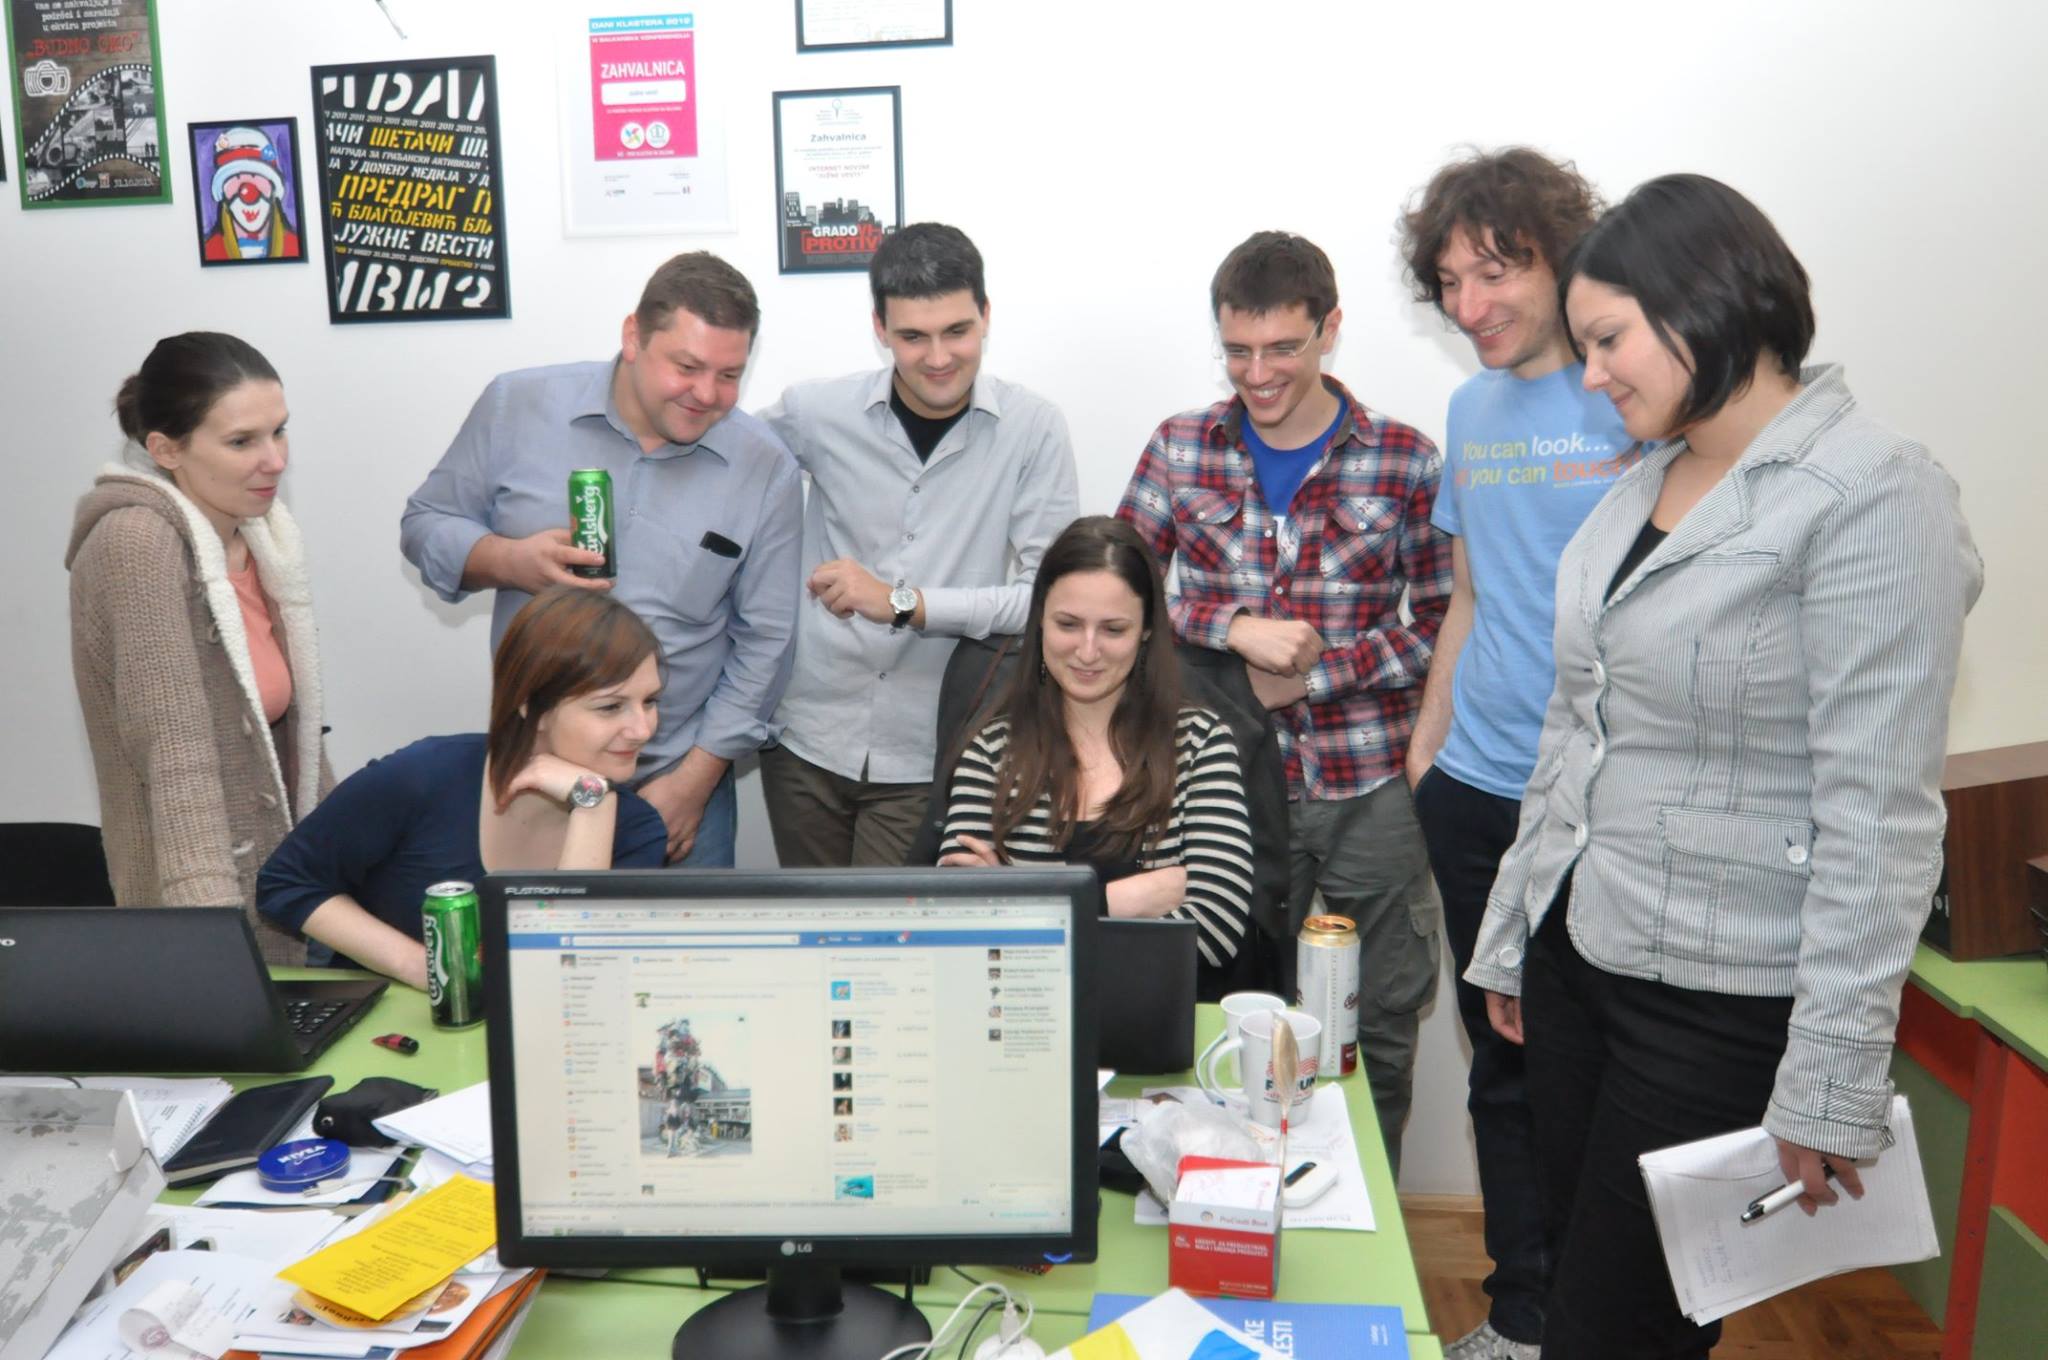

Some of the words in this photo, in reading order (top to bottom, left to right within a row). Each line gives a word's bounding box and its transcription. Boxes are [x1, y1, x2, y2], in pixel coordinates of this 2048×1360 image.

[591, 22, 614, 30] DANI
[616, 19, 666, 28] KLASTERA
[600, 60, 686, 80] ZAHVALNICA
[369, 127, 455, 154] ШЕТАЧИ
[810, 132, 867, 143] Zahvalnica
[330, 146, 367, 158] НАГРАДА
[368, 150, 380, 159] ЗА
[431, 157, 482, 170] АКТИВИЗАМ
[349, 159, 358, 171] У
[359, 160, 409, 176] ДОМЕНУ
[411, 166, 459, 183] МЕДИЈА
[338, 174, 466, 210] ПРЕДРАГ
[348, 204, 457, 232] БЛАГОЈЕВИЋ
[333, 222, 415, 250] ЈУЖНЕ
[420, 231, 495, 259] ВЕСТИ
[804, 236, 880, 252] PROTIV
[1463, 440, 1488, 461] You
[1491, 441, 1528, 459] can
[1532, 432, 1610, 456] look...
[1470, 467, 1502, 491] you
[1507, 464, 1547, 485] can
[503, 886, 560, 896] FLATRON
[797, 1242, 812, 1253] LG
